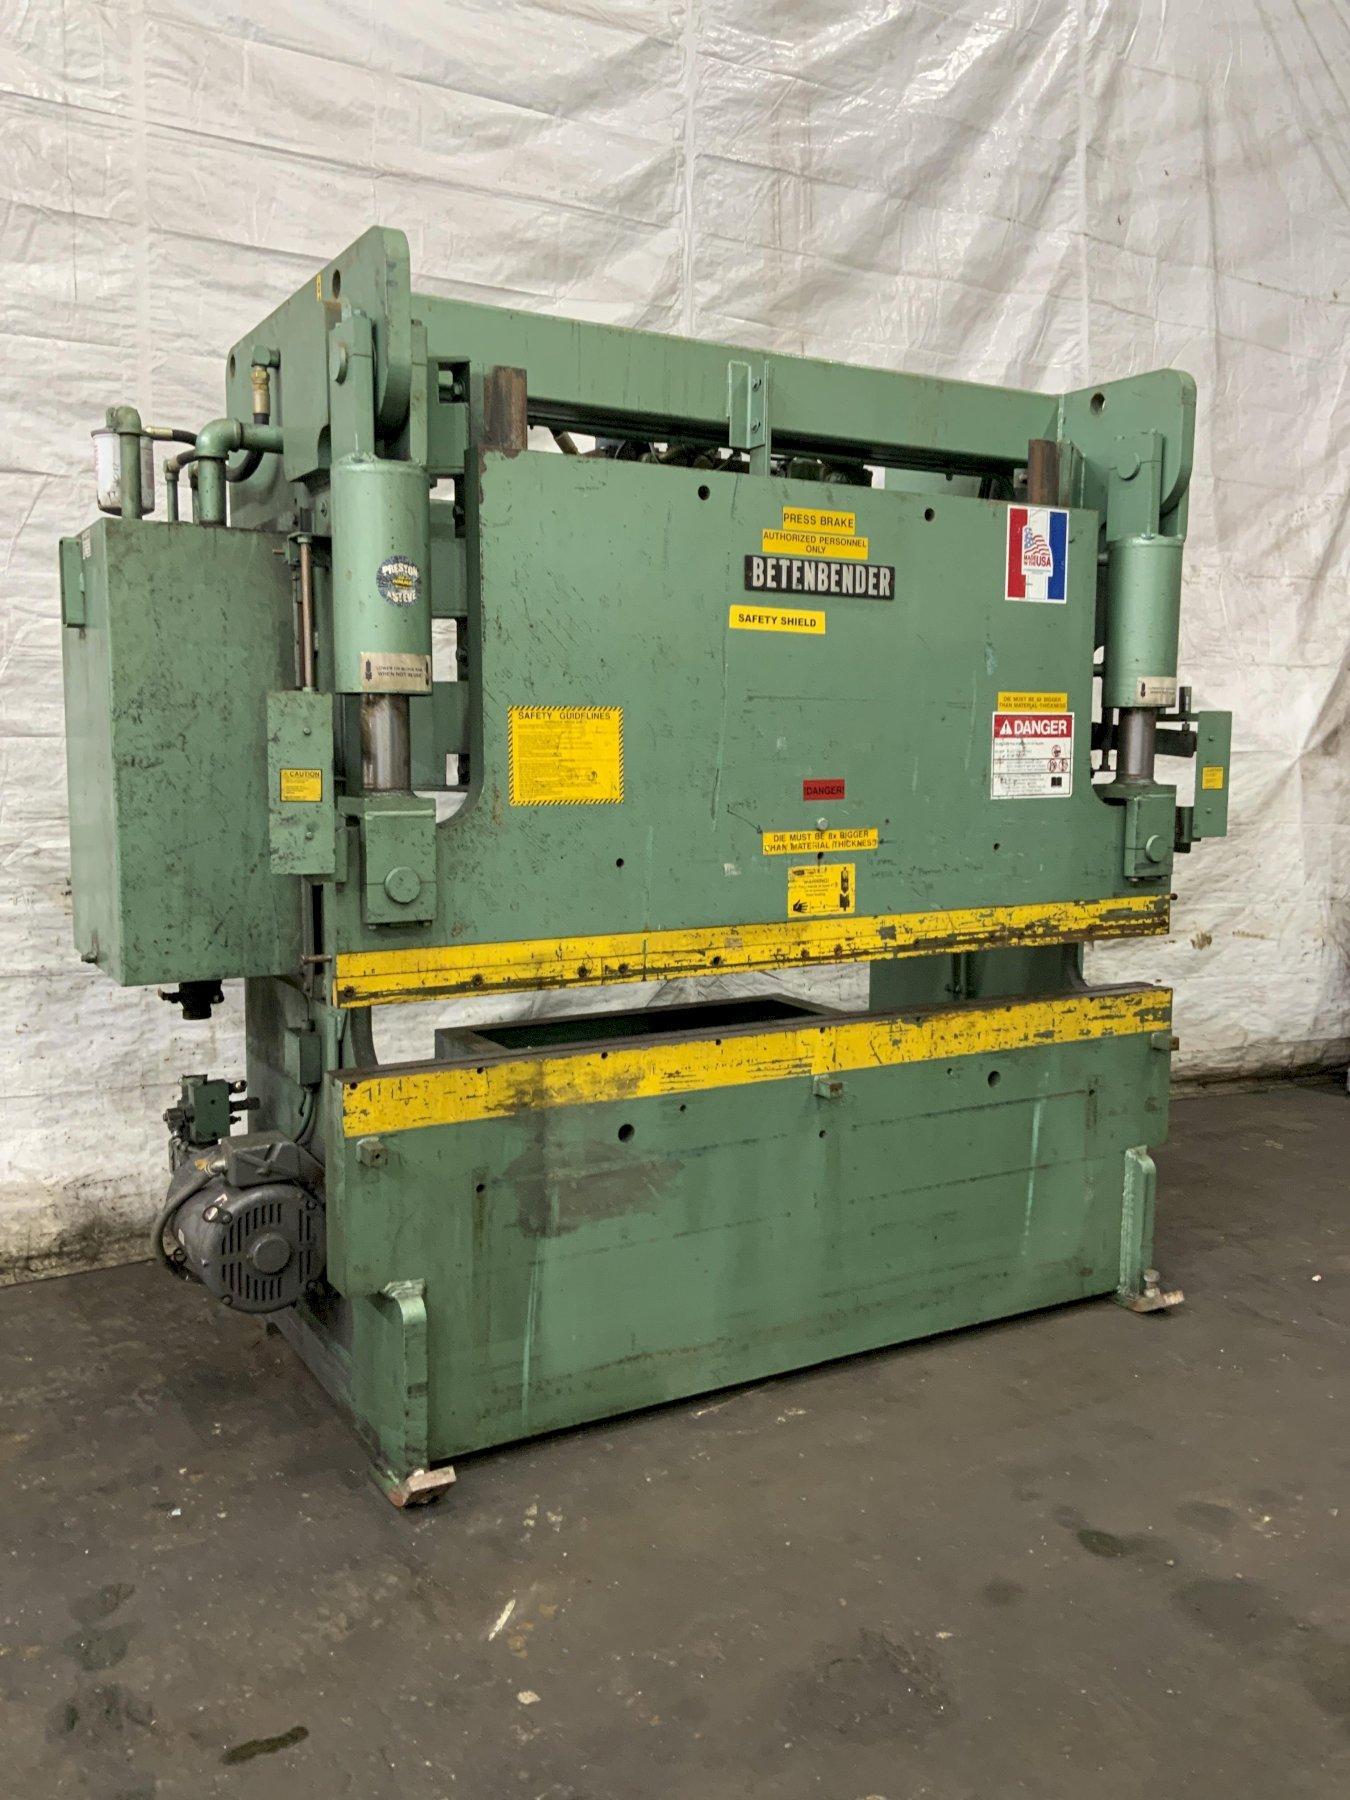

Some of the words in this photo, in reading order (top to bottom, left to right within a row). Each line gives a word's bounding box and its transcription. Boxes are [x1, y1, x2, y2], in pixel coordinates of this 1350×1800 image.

[783, 512, 817, 525] PRESS
[820, 516, 854, 528] BRAKE
[763, 531, 816, 543] AUTHORIZED
[819, 536, 867, 548] PERSONNEL
[805, 545, 826, 554] ONLY
[1037, 556, 1051, 567] USA
[381, 562, 418, 578] PRESTON
[752, 556, 891, 597] BETENBENDER
[738, 613, 778, 625] SAFETY
[781, 616, 817, 628] SHIELD
[518, 711, 553, 720] SAFETY
[559, 711, 611, 720] GUIDELINES
[1014, 719, 1067, 735] DANGER
[773, 834, 786, 842] DIE
[789, 833, 812, 841] MUST
[814, 832, 825, 840] BE
[839, 830, 869, 839] BIGGER
[790, 841, 829, 850] MATERIAL
